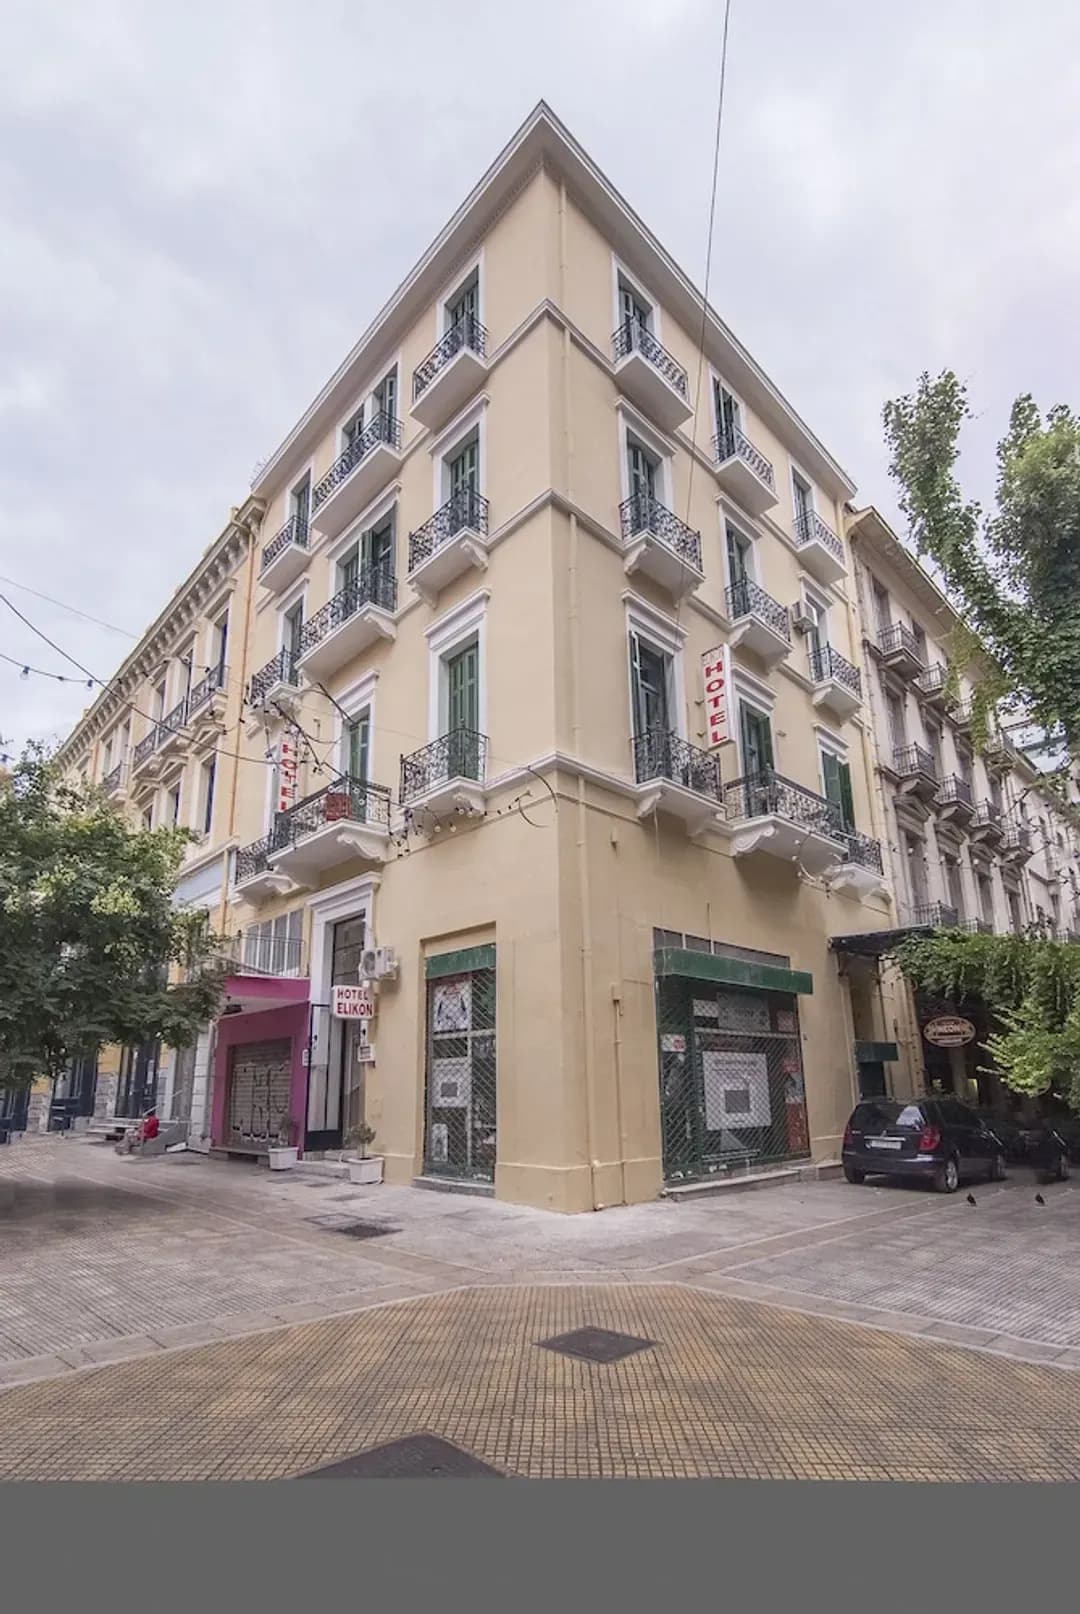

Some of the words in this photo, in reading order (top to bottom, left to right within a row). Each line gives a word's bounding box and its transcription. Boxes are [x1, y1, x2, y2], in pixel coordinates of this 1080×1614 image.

[705, 661, 727, 743] HOTEL
[337, 988, 369, 1001] HOTEL
[337, 1003, 373, 1016] ELIKON
